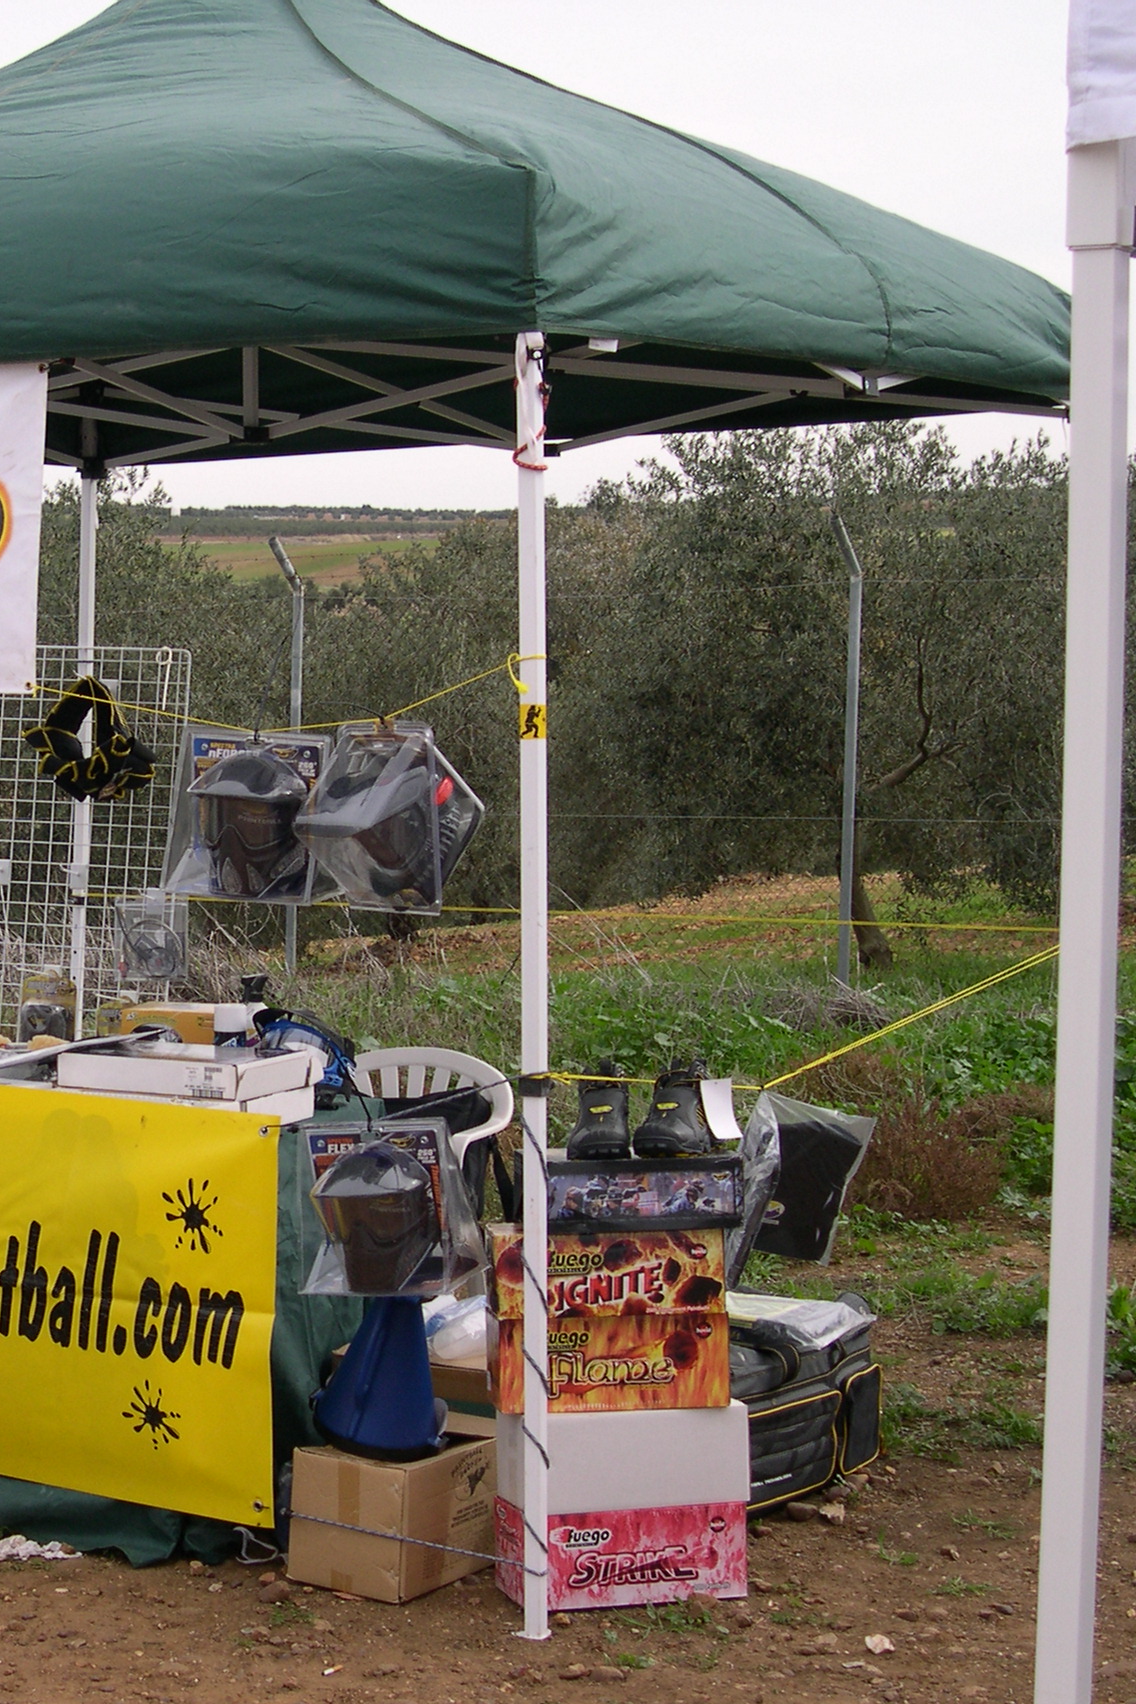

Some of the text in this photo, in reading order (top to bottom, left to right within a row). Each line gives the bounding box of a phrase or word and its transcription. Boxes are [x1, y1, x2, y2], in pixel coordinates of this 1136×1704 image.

[554, 1262, 663, 1311] IGNITE
[548, 1331, 589, 1347] uego
[567, 1528, 610, 1545] fuego
[568, 1545, 699, 1588] STRIKE
